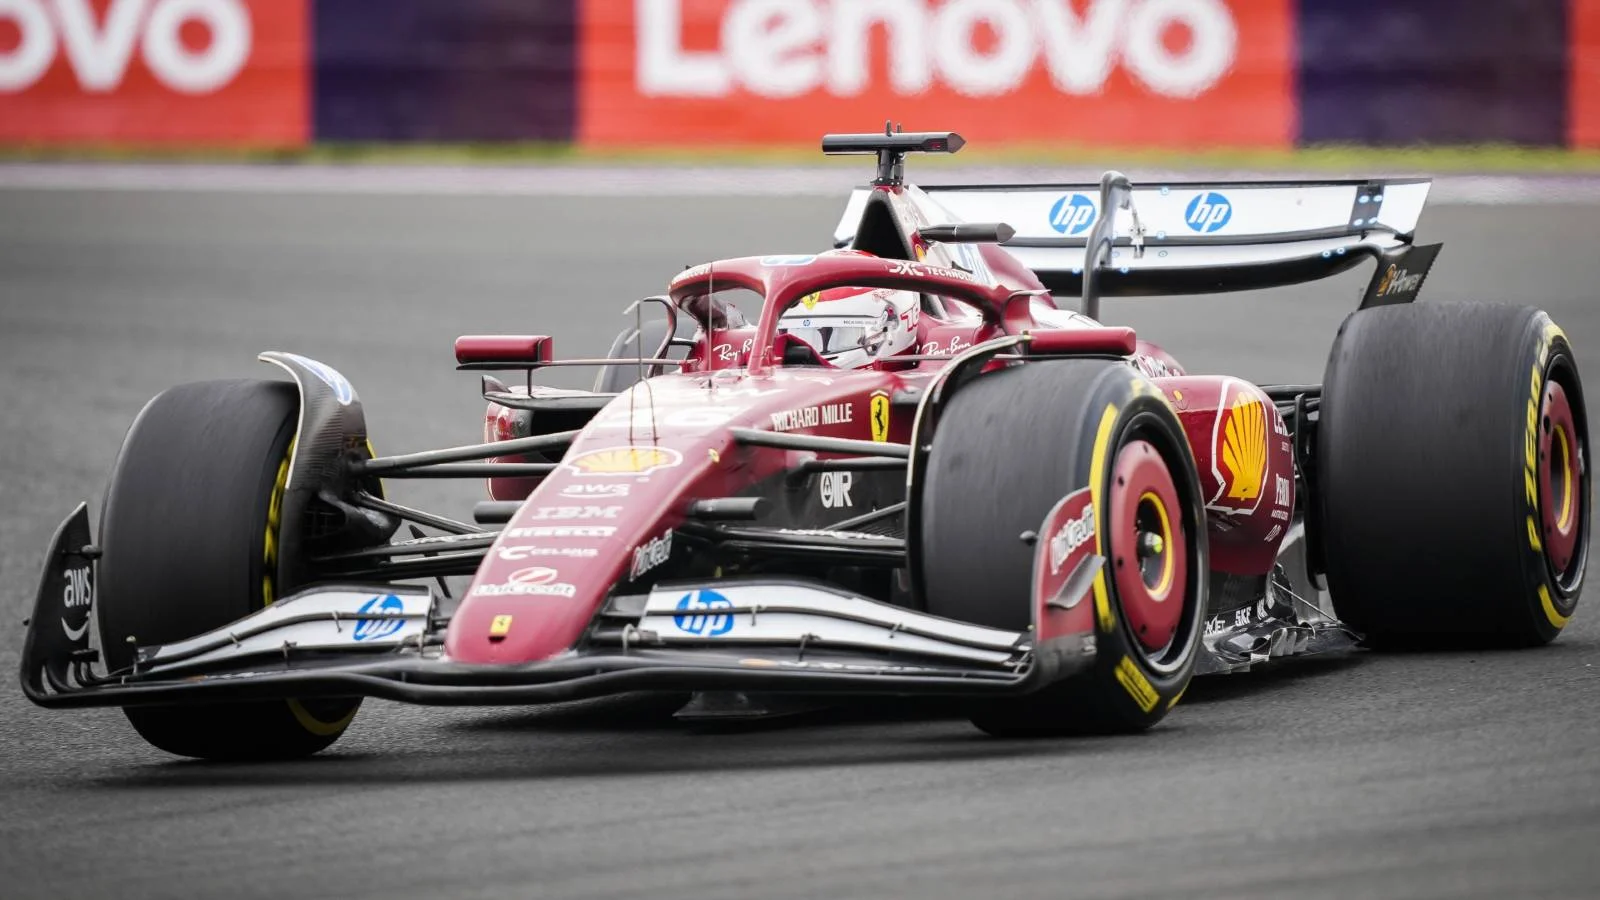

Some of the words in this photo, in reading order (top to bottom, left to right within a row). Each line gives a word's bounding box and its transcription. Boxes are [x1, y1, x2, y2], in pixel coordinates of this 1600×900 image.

[636, 0, 1239, 99] Lenovo
[1050, 194, 1097, 234] hp
[1185, 192, 1232, 232] hp
[712, 338, 753, 361] Ray-B
[770, 406, 820, 432] RICHARD
[821, 402, 853, 425] MILLE
[1524, 363, 1541, 512] ZERO
[531, 505, 624, 521] IBM
[63, 565, 92, 608] aws
[674, 589, 734, 636] hp
[1235, 606, 1252, 627] SKF
